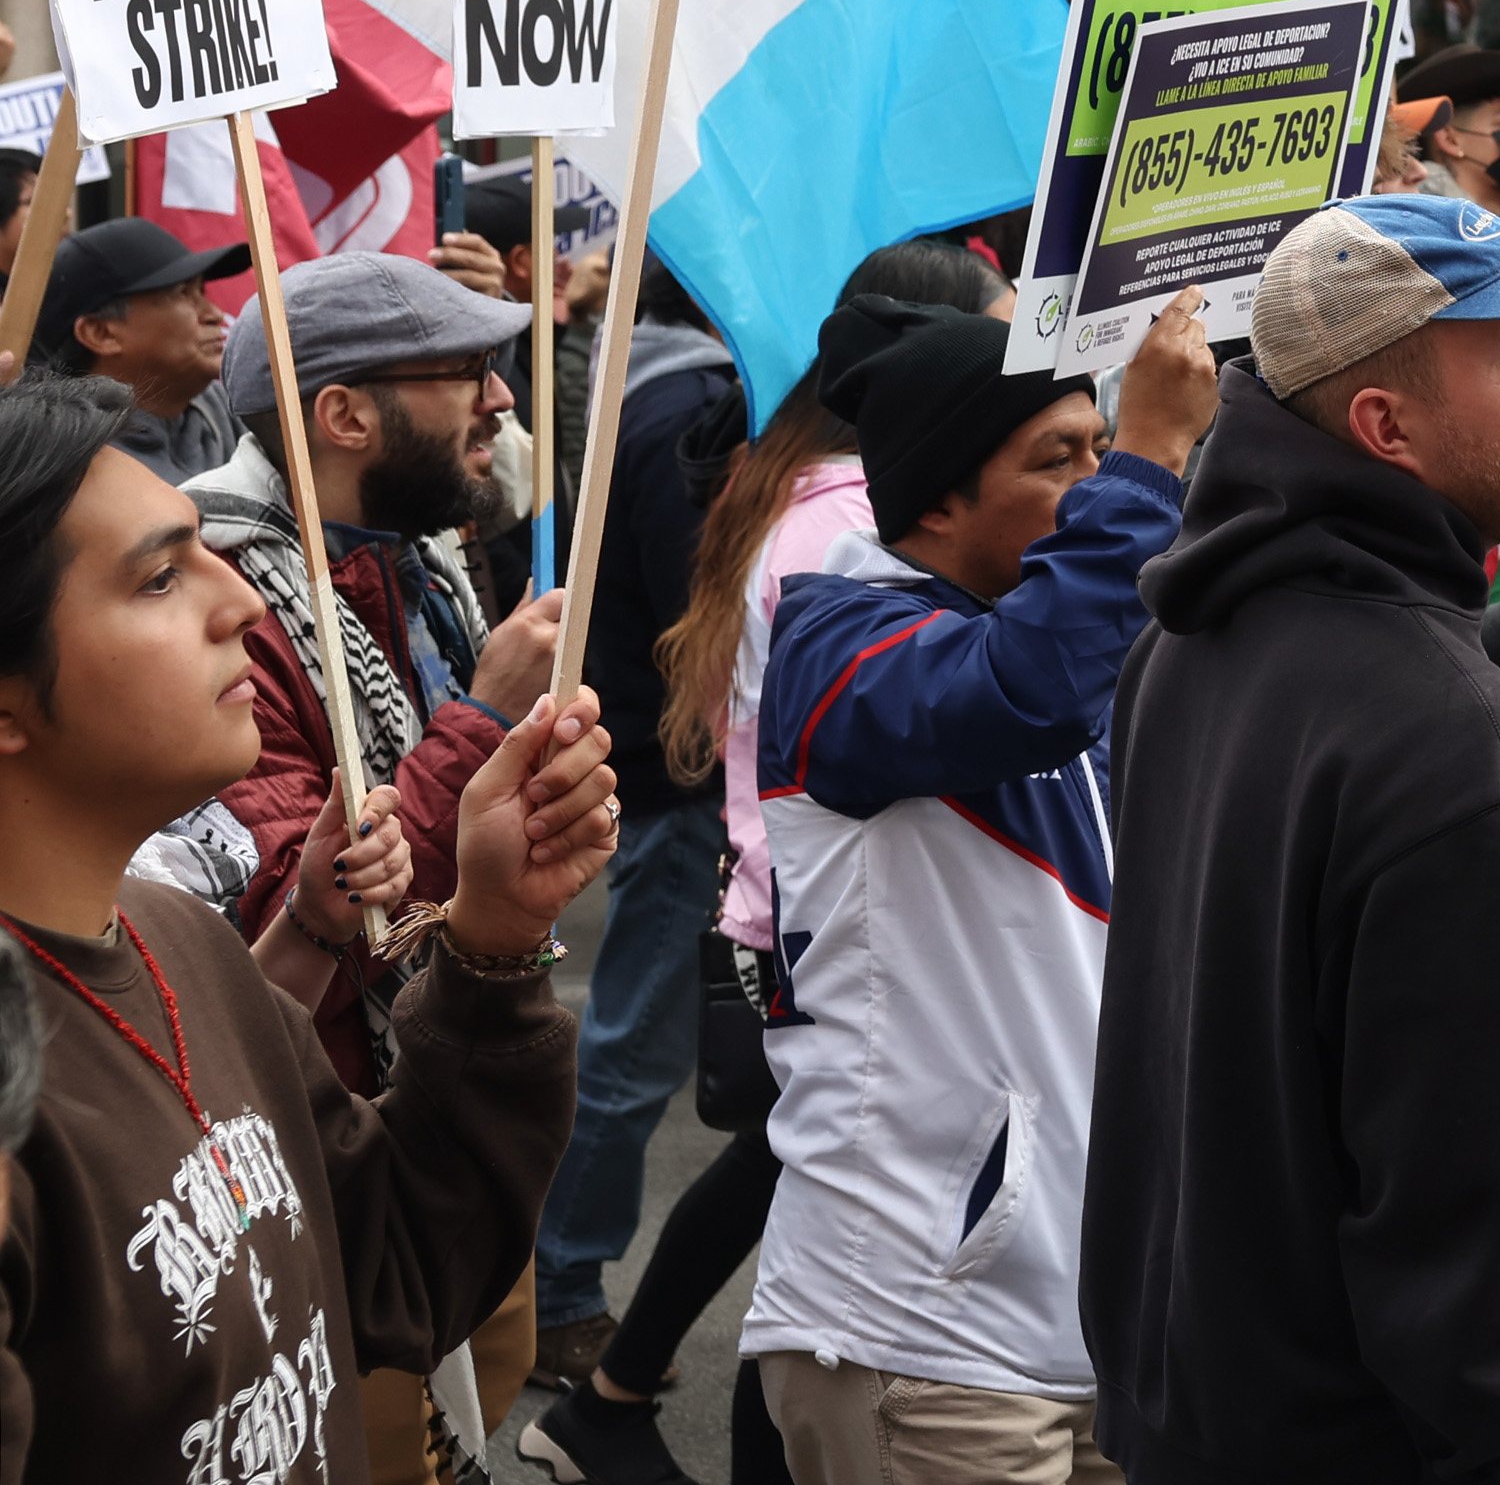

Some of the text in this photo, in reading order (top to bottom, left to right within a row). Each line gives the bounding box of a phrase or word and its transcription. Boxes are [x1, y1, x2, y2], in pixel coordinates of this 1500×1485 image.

[1171, 39, 1211, 65] ¿NECESITA
[1210, 35, 1239, 56] APOYO
[1238, 31, 1262, 51] LEGAL
[1262, 30, 1275, 48] DE
[1188, 46, 1305, 83] ¿VIO A ICE EN SU COMUNIDAD?
[1155, 63, 1329, 107] LLAME A LA LÍNEA DIRECTA DE APOYO FAMILIAR
[1120, 105, 1335, 208] (855)-435-7693
[1193, 194, 1203, 205] EN
[1203, 190, 1219, 203] VIVO
[1219, 189, 1228, 201] EN
[1228, 183, 1252, 198] INGLÉS
[1257, 179, 1286, 193] ESPAÑOL
[1136, 220, 1282, 262] REPORTE CUALQUIER ACTIVIDAD DE ICE
[1144, 237, 1265, 275] APOYO LEGAL DE DEPORTACIÓN
[1118, 275, 1162, 296] REFERENCIAS
[1161, 270, 1181, 285] PARA
[1181, 263, 1216, 280] SERVICIOS
[1215, 257, 1246, 273] LEGALES
[1247, 256, 1253, 266] Y
[1232, 289, 1246, 302] PARA
[1095, 330, 1103, 339] FOR
